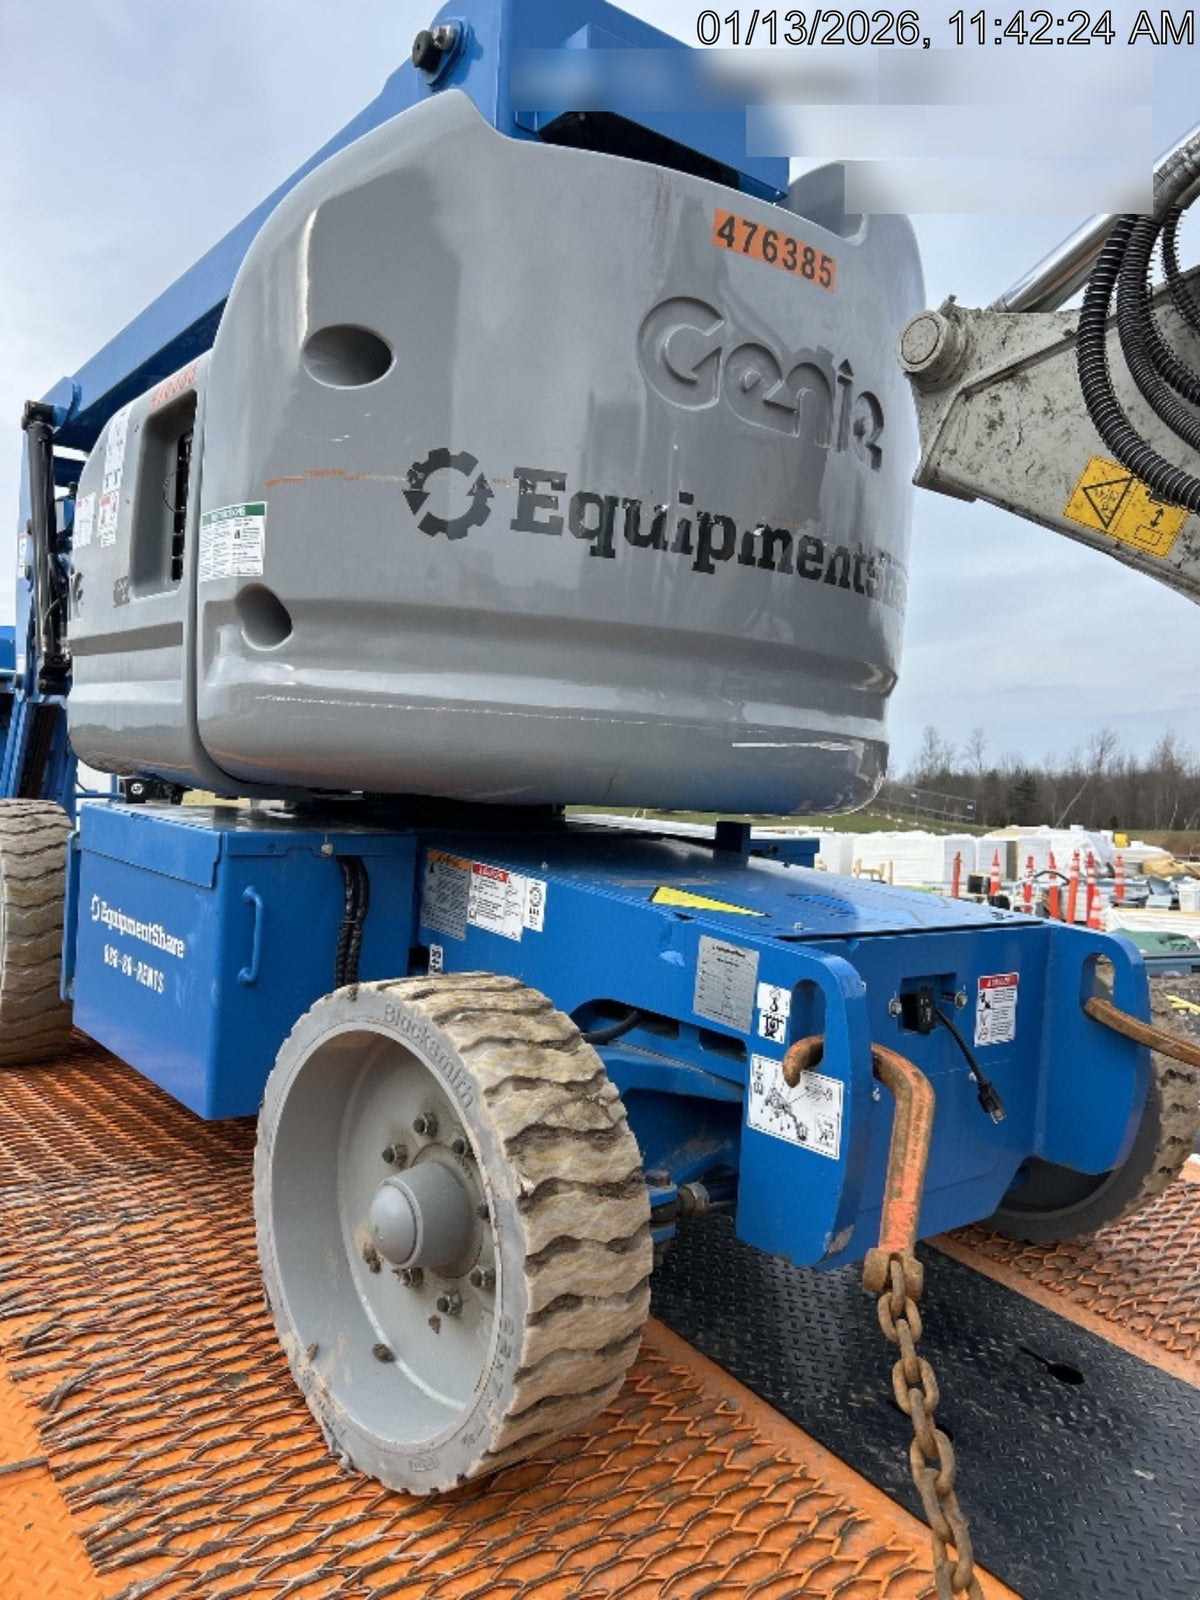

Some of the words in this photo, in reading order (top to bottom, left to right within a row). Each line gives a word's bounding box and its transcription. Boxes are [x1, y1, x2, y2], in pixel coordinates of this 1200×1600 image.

[716, 213, 833, 290] 476385
[637, 296, 885, 472] Genie
[100, 900, 185, 960] EquipmentShare
